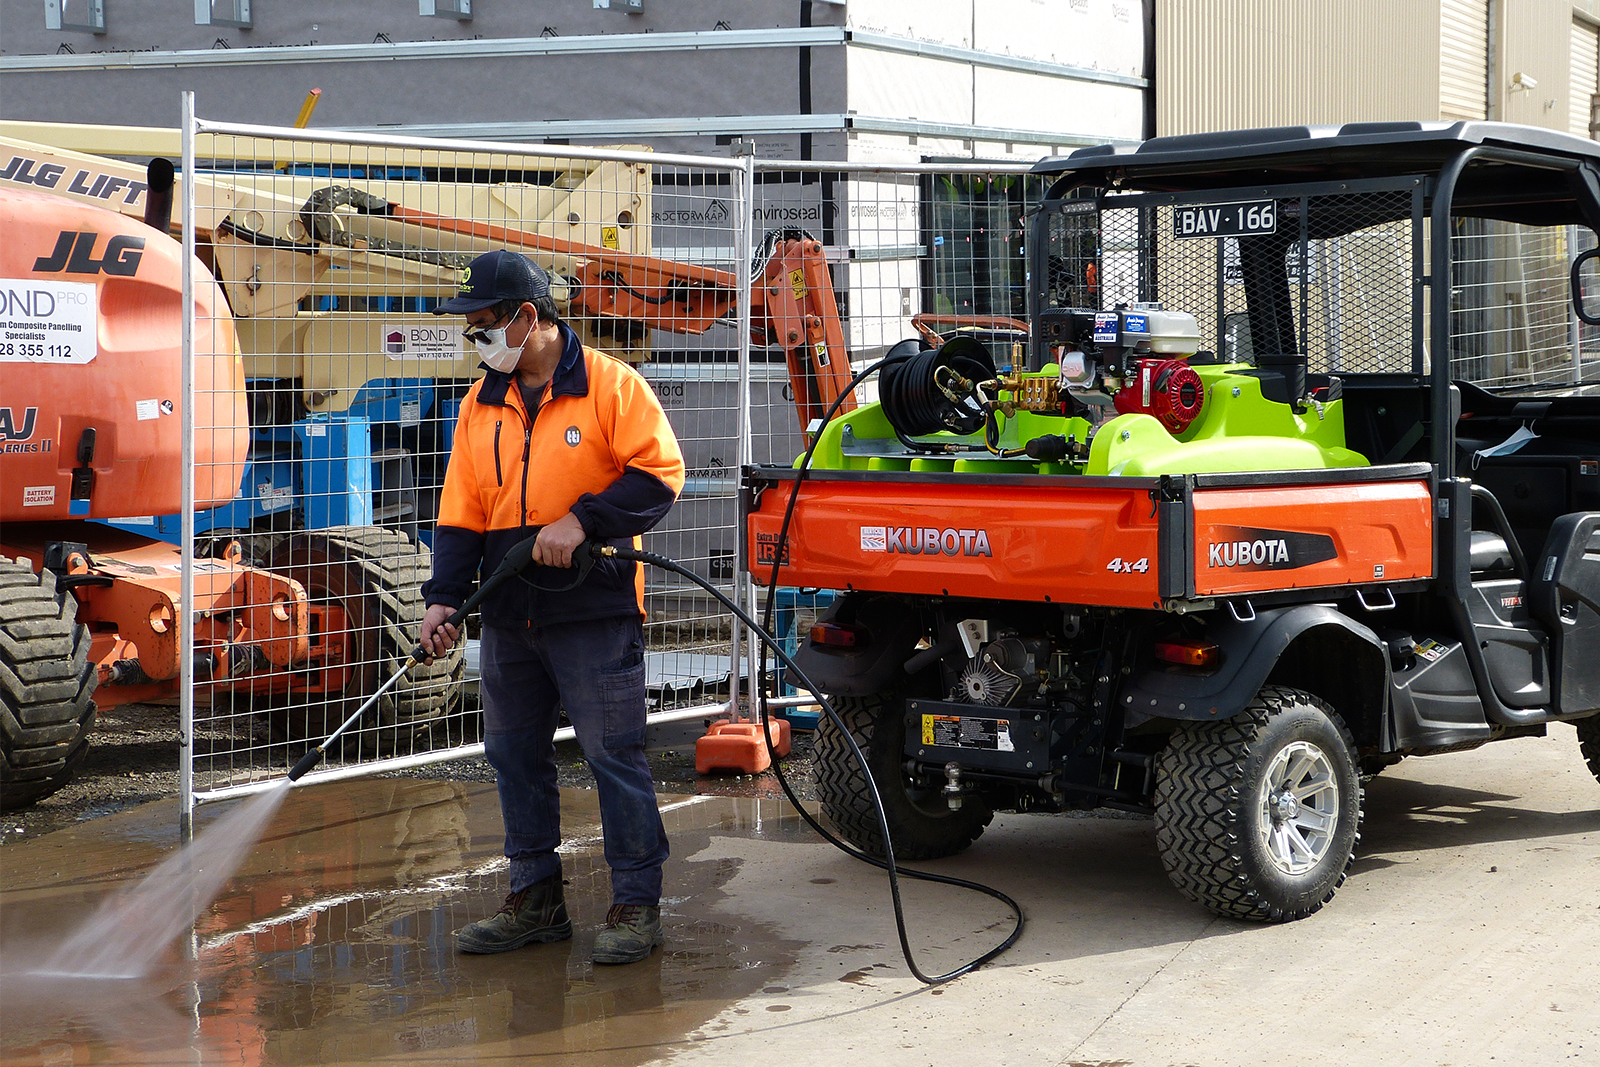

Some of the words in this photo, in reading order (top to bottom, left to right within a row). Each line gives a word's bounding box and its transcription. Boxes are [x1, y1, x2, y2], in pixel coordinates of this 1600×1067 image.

[0, 156, 67, 190] JLG
[66, 169, 148, 205] LIFT
[753, 204, 821, 220] nviroseal
[1182, 208, 1221, 234] BAV
[1238, 205, 1273, 230] 166
[32, 231, 146, 277] JLG
[0, 289, 56, 317] ND
[57, 291, 88, 305] PRO
[8, 321, 47, 330] Composite
[48, 322, 82, 332] Panelling
[411, 329, 448, 341] BOND
[5, 332, 46, 340] Specialists
[18, 344, 43, 356] 355
[48, 345, 72, 358] 112
[887, 526, 993, 557] KUBOTA
[1209, 539, 1290, 567] KUBOTA
[712, 559, 734, 569] CSR
[1106, 557, 1150, 574] 4x4
